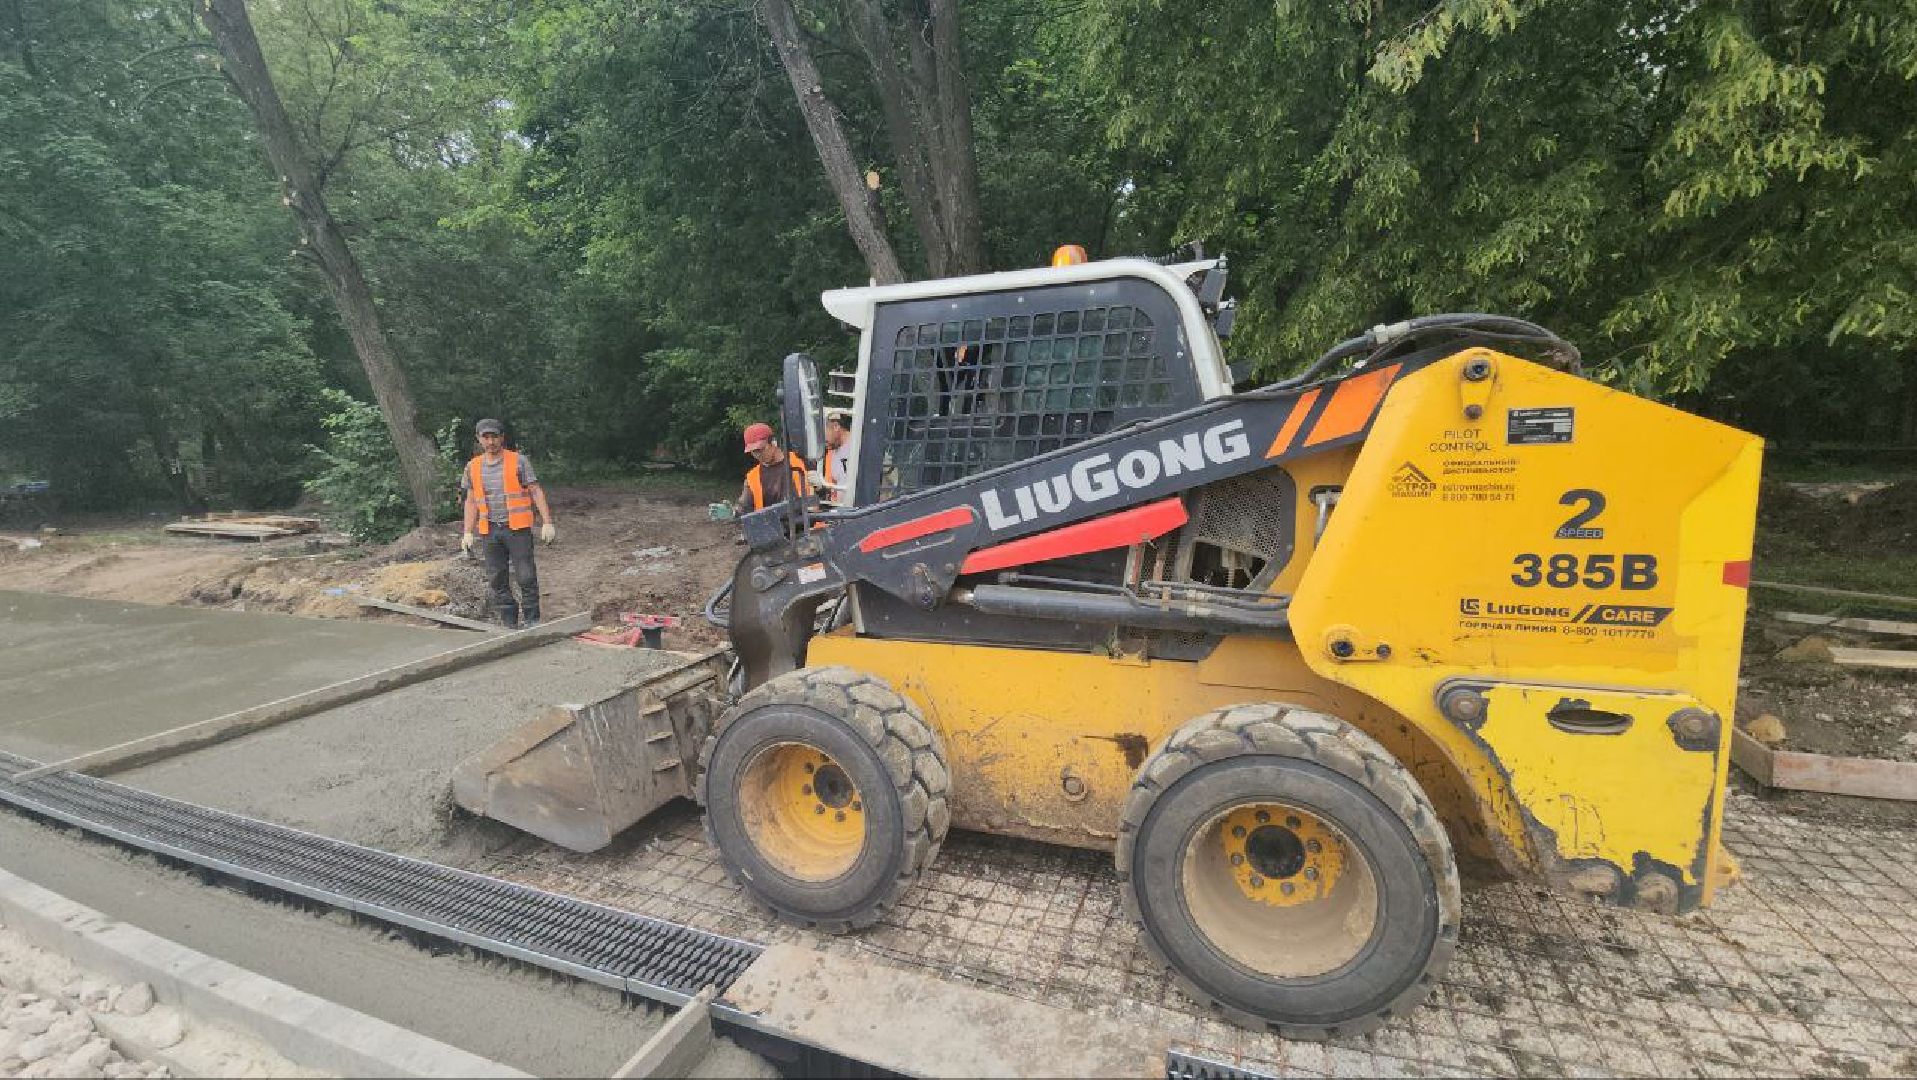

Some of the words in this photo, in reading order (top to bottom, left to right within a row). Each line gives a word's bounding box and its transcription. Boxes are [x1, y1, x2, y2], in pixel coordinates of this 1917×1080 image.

[1445, 429, 1480, 439] PILOT
[1429, 441, 1491, 452] CONTROL
[1554, 488, 1607, 539] 2
[1558, 528, 1603, 537] SPEED
[1511, 553, 1659, 590] 385B
[1602, 609, 1655, 623] CARE
